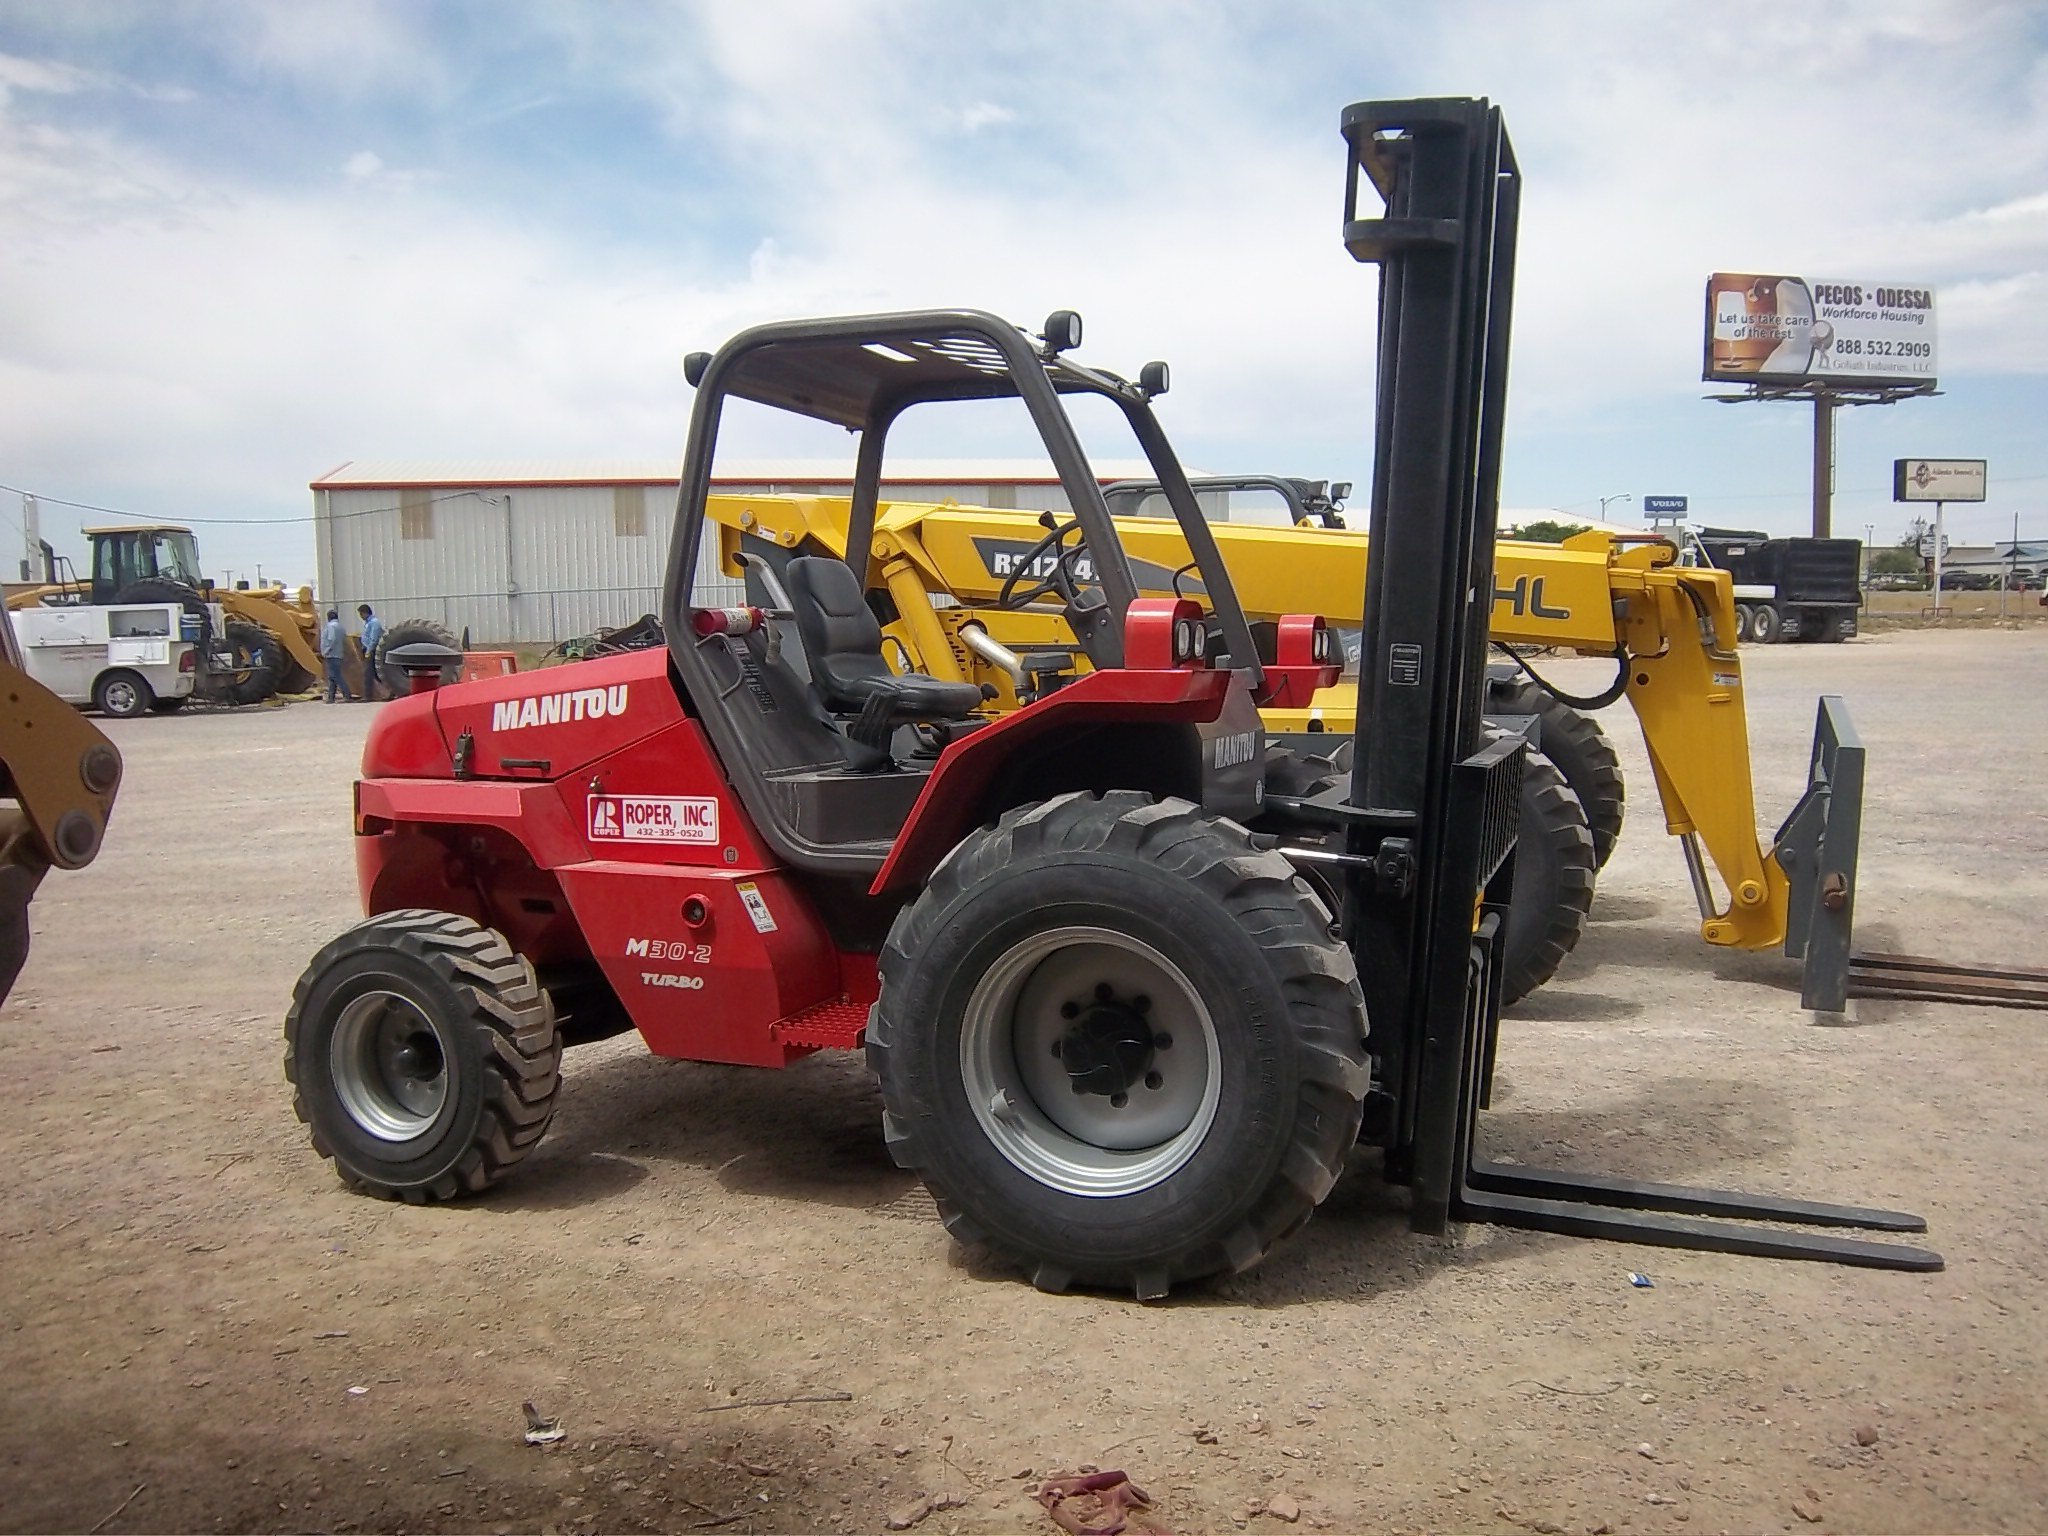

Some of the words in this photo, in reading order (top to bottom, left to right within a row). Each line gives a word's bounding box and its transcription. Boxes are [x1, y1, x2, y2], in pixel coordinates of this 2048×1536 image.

[1815, 285, 1863, 306] PECOS
[1876, 288, 1932, 309] ODESSA
[1719, 313, 1737, 324] Let
[1741, 315, 1754, 324] us
[1758, 313, 1781, 325] take
[1785, 317, 1809, 326] care
[1822, 307, 1878, 320] Workforce
[1880, 310, 1925, 325] Housing
[1734, 326, 1745, 338] of
[1749, 327, 1767, 338] the
[1836, 339, 1930, 357] 888.532.2909
[1651, 500, 1684, 508] VOLVO
[994, 552, 1100, 580] RS124
[493, 684, 628, 731] MANITOU
[1215, 731, 1255, 769] MANITOU
[625, 803, 677, 828] ROPER,
[684, 805, 712, 827] INC.
[594, 828, 620, 836] ROPER
[637, 828, 704, 838] 432-335-0520
[625, 937, 712, 963] M30-2
[641, 972, 704, 990] TURBO
